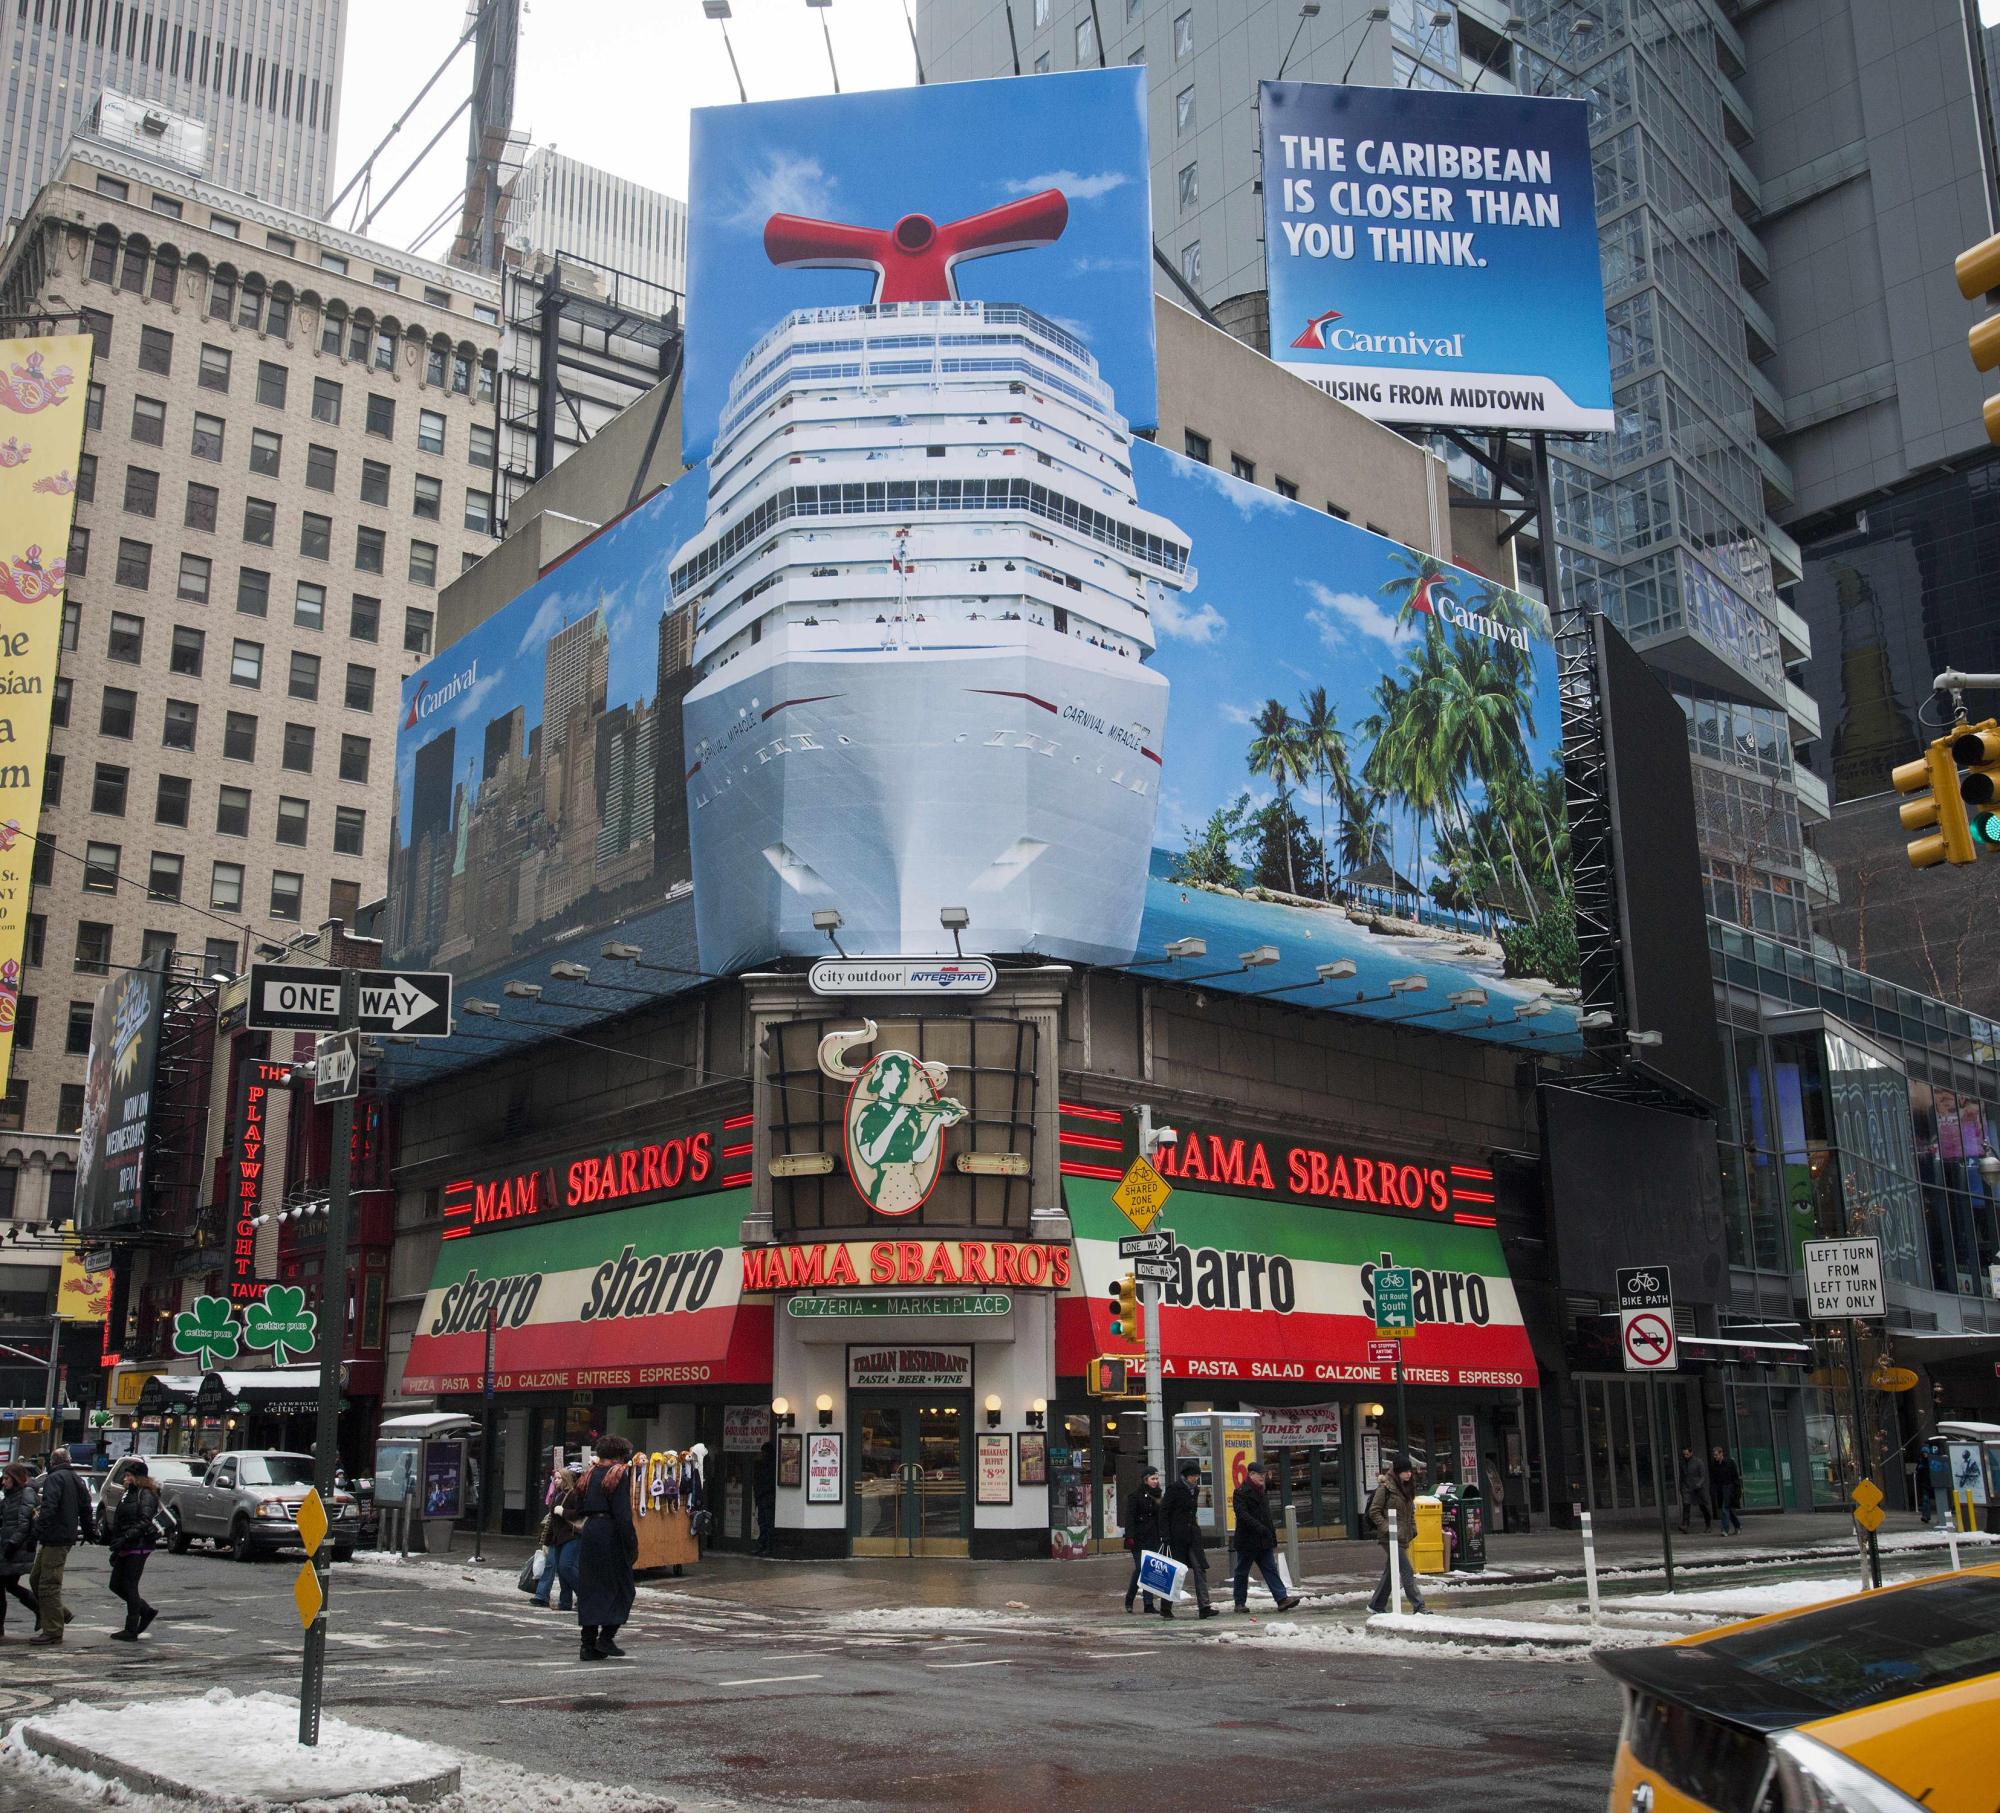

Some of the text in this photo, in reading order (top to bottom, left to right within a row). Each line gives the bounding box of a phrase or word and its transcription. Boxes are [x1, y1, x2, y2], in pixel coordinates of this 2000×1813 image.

[1280, 134, 1552, 184] THE CARIBBEAN
[1283, 178, 1561, 228] IS CLOSER THAN
[1281, 221, 1488, 267] YOU THINK.
[1331, 330, 1463, 358] Carnival
[1389, 384, 1443, 406] FROM
[1450, 388, 1545, 412] MIDTOWN
[1438, 597, 1530, 653] Carnival
[421, 658, 478, 718] Carnival
[727, 712, 757, 744] MIRACLE
[1063, 705, 1141, 751] CARNIVAL MIRACLE
[819, 970, 987, 985] city outdoor INTERSTATE
[280, 986, 419, 1016] ONE WAY
[259, 1066, 291, 1080] THE
[320, 1052, 351, 1082] ONE WAY
[123, 1091, 149, 1123] NOW ON
[106, 1121, 146, 1156] WEDNESDAYS
[119, 1166, 136, 1193] 10PM
[235, 1087, 264, 1275] PLAYWRIGHT
[567, 1131, 712, 1207] SBARRO'S
[1289, 1148, 1448, 1213] SBARRO'S
[1125, 1184, 1158, 1196] SHARED
[1131, 1195, 1152, 1206] ZONE
[1129, 1205, 1157, 1216] AHEAD
[1126, 1239, 1163, 1252] ONE WAY
[1811, 1247, 1874, 1262] LEFT TURN
[742, 1241, 1071, 1289] MAMA SBARRO'S
[1141, 1265, 1173, 1276] ONE WAY
[1828, 1264, 1859, 1277] FROM
[580, 1245, 723, 1322] sbarro
[1390, 1292, 1408, 1300] Route
[1814, 1279, 1877, 1293] LEFT TURN
[431, 1271, 543, 1337] sbarro
[1382, 1301, 1406, 1311] South
[1622, 1295, 1669, 1306] BIKE PATH
[1818, 1296, 1875, 1309] BAY ONLY
[852, 1350, 968, 1372] ITALIAN RESTAURANT
[1126, 1359, 1522, 1386] PIZA PASTA SALAD CALZONE ENTREES ESPRESSO
[409, 1380, 435, 1392] PIZZA
[442, 1378, 470, 1390] PASTA
[519, 1373, 569, 1387] CALZONE
[577, 1370, 631, 1385] ENTREES
[639, 1365, 711, 1382] ESPRESSO
[857, 1375, 963, 1384] PASTA BEER WINE
[1306, 1423, 1338, 1433] SOUPS
[980, 1448, 1009, 1457] BREAKFAST
